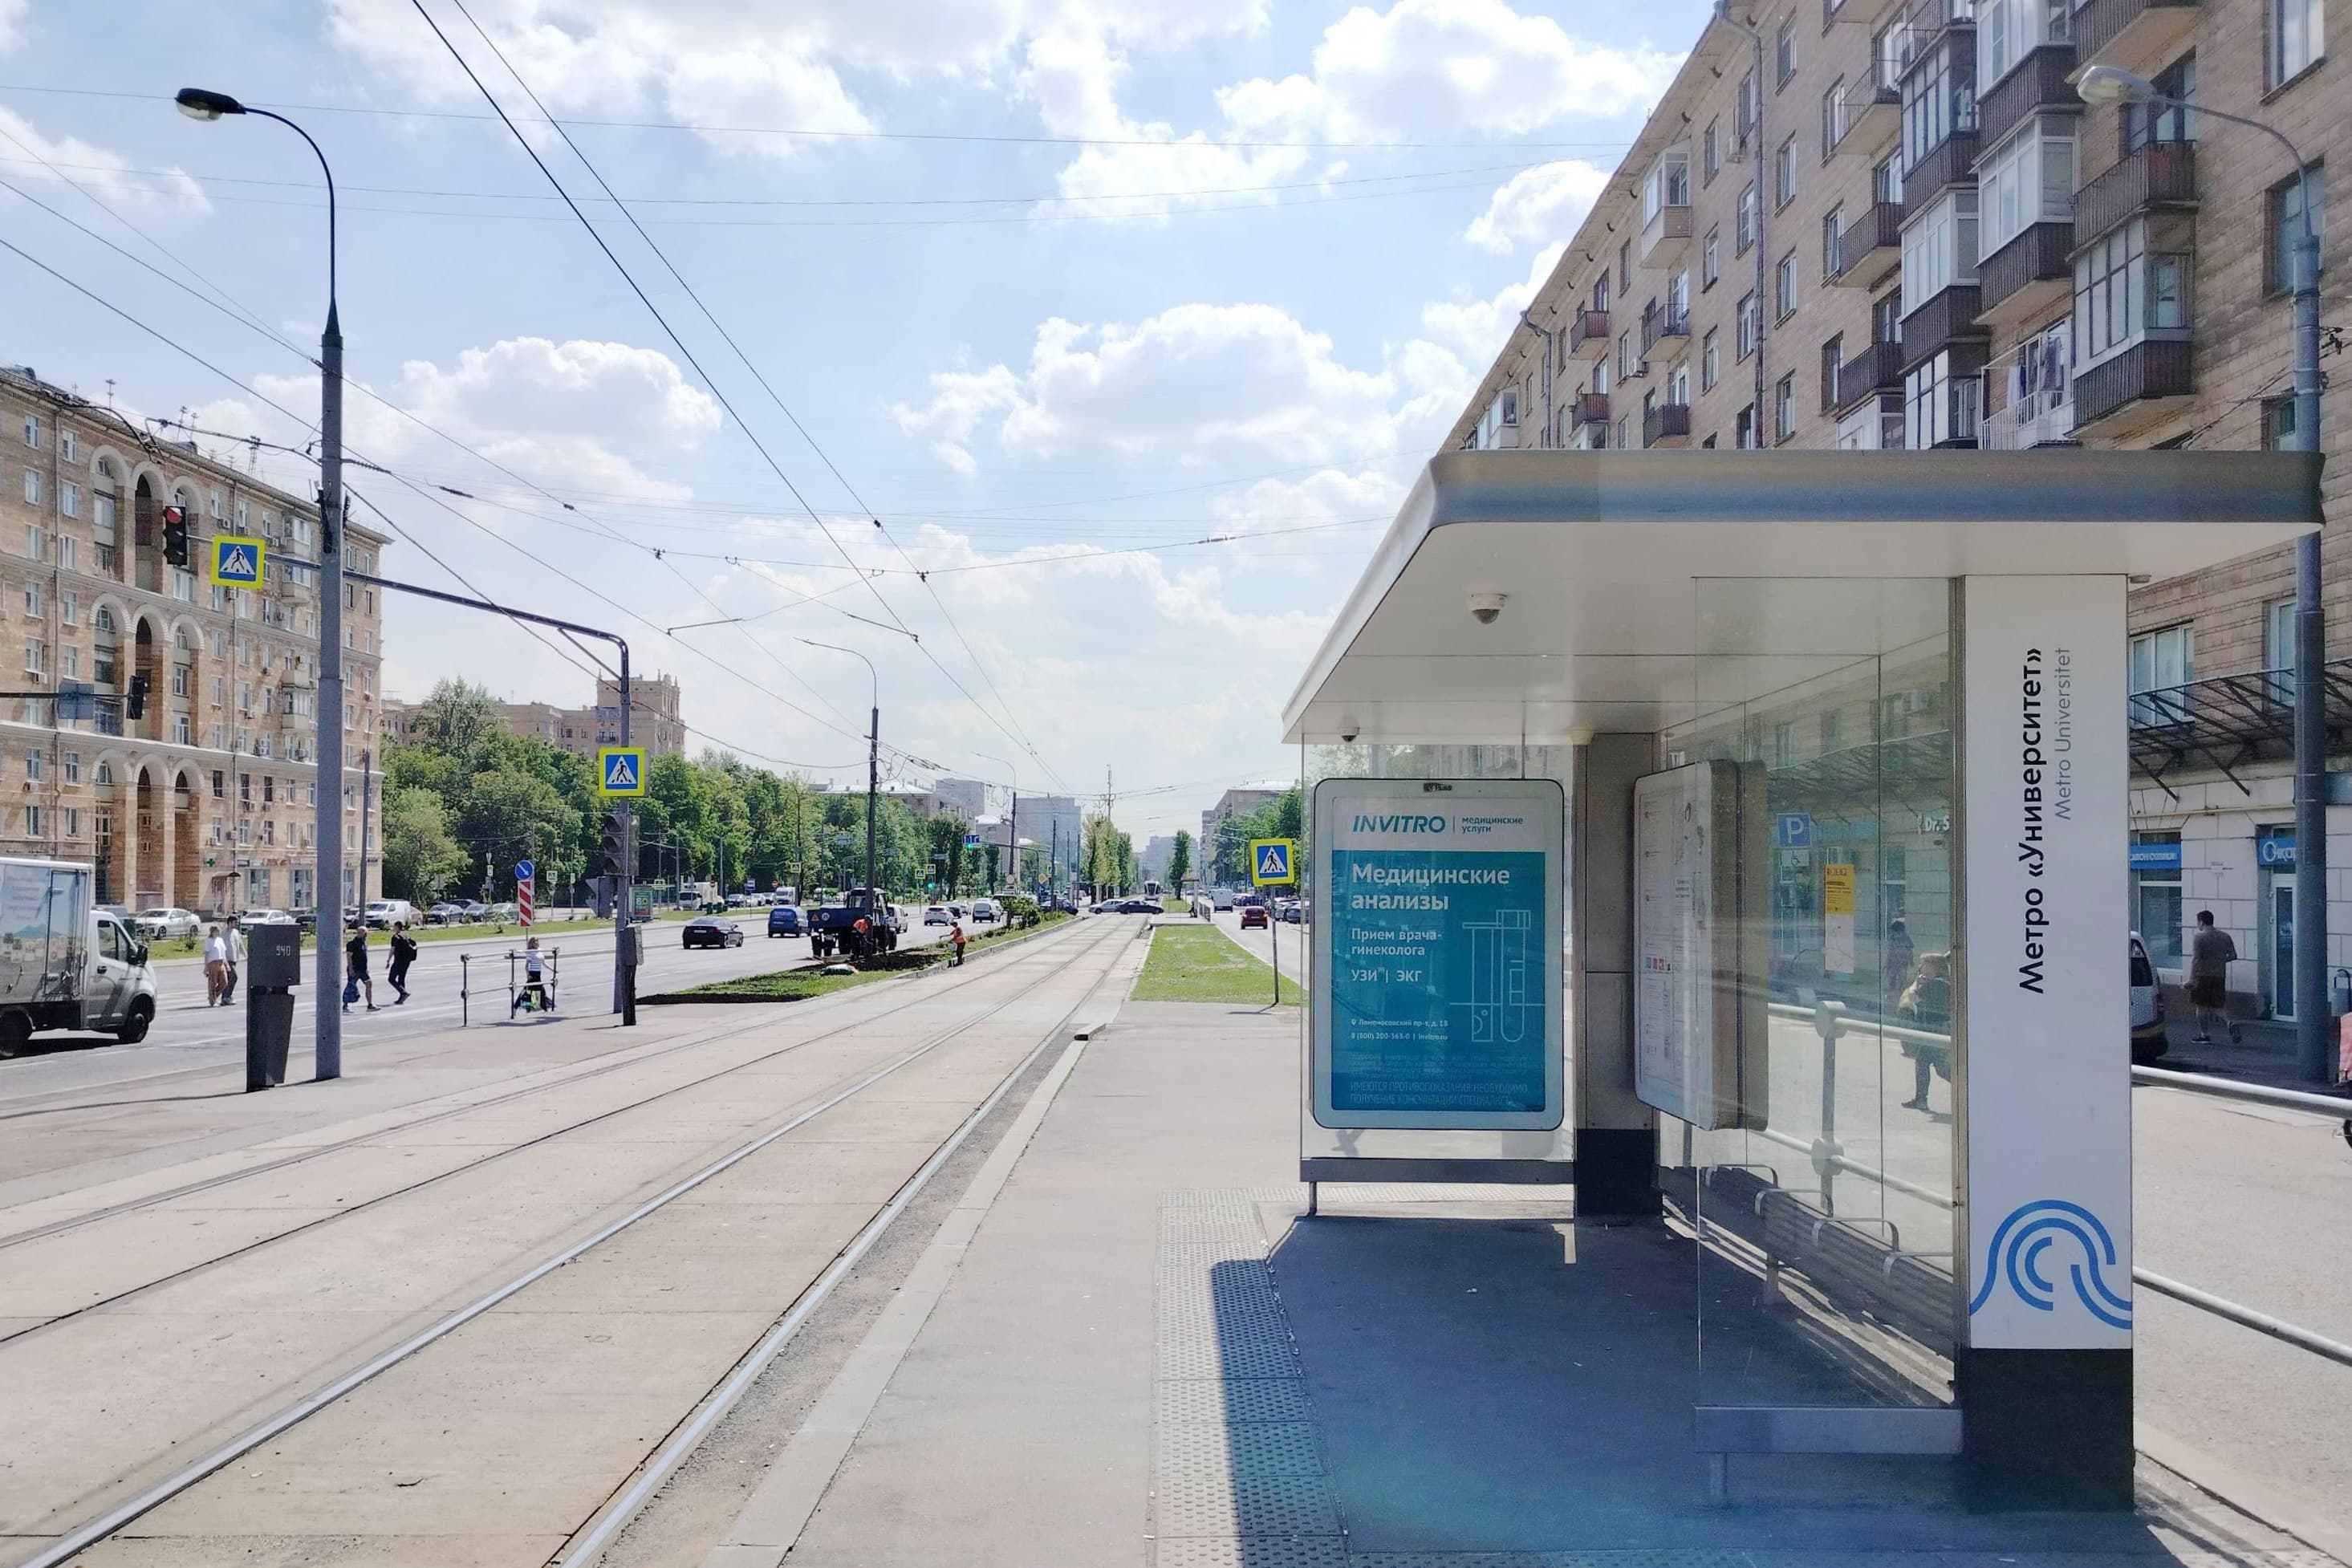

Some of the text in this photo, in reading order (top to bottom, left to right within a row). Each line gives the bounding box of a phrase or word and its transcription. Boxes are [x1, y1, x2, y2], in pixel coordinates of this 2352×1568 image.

[2054, 647, 2071, 820] Metro Universitet
[1352, 814, 1446, 834] INVITRO
[1461, 816, 1524, 826] медицинские
[2018, 648, 2049, 994] Метро «Университет»
[1461, 825, 1492, 835] услуги
[1352, 863, 1510, 888] Медицинские
[1351, 893, 1449, 911] анализы
[1351, 928, 1442, 943] Прием врача-
[1351, 945, 1425, 956] гинеколога
[1351, 969, 1422, 982] УЗИ ЭКГ
